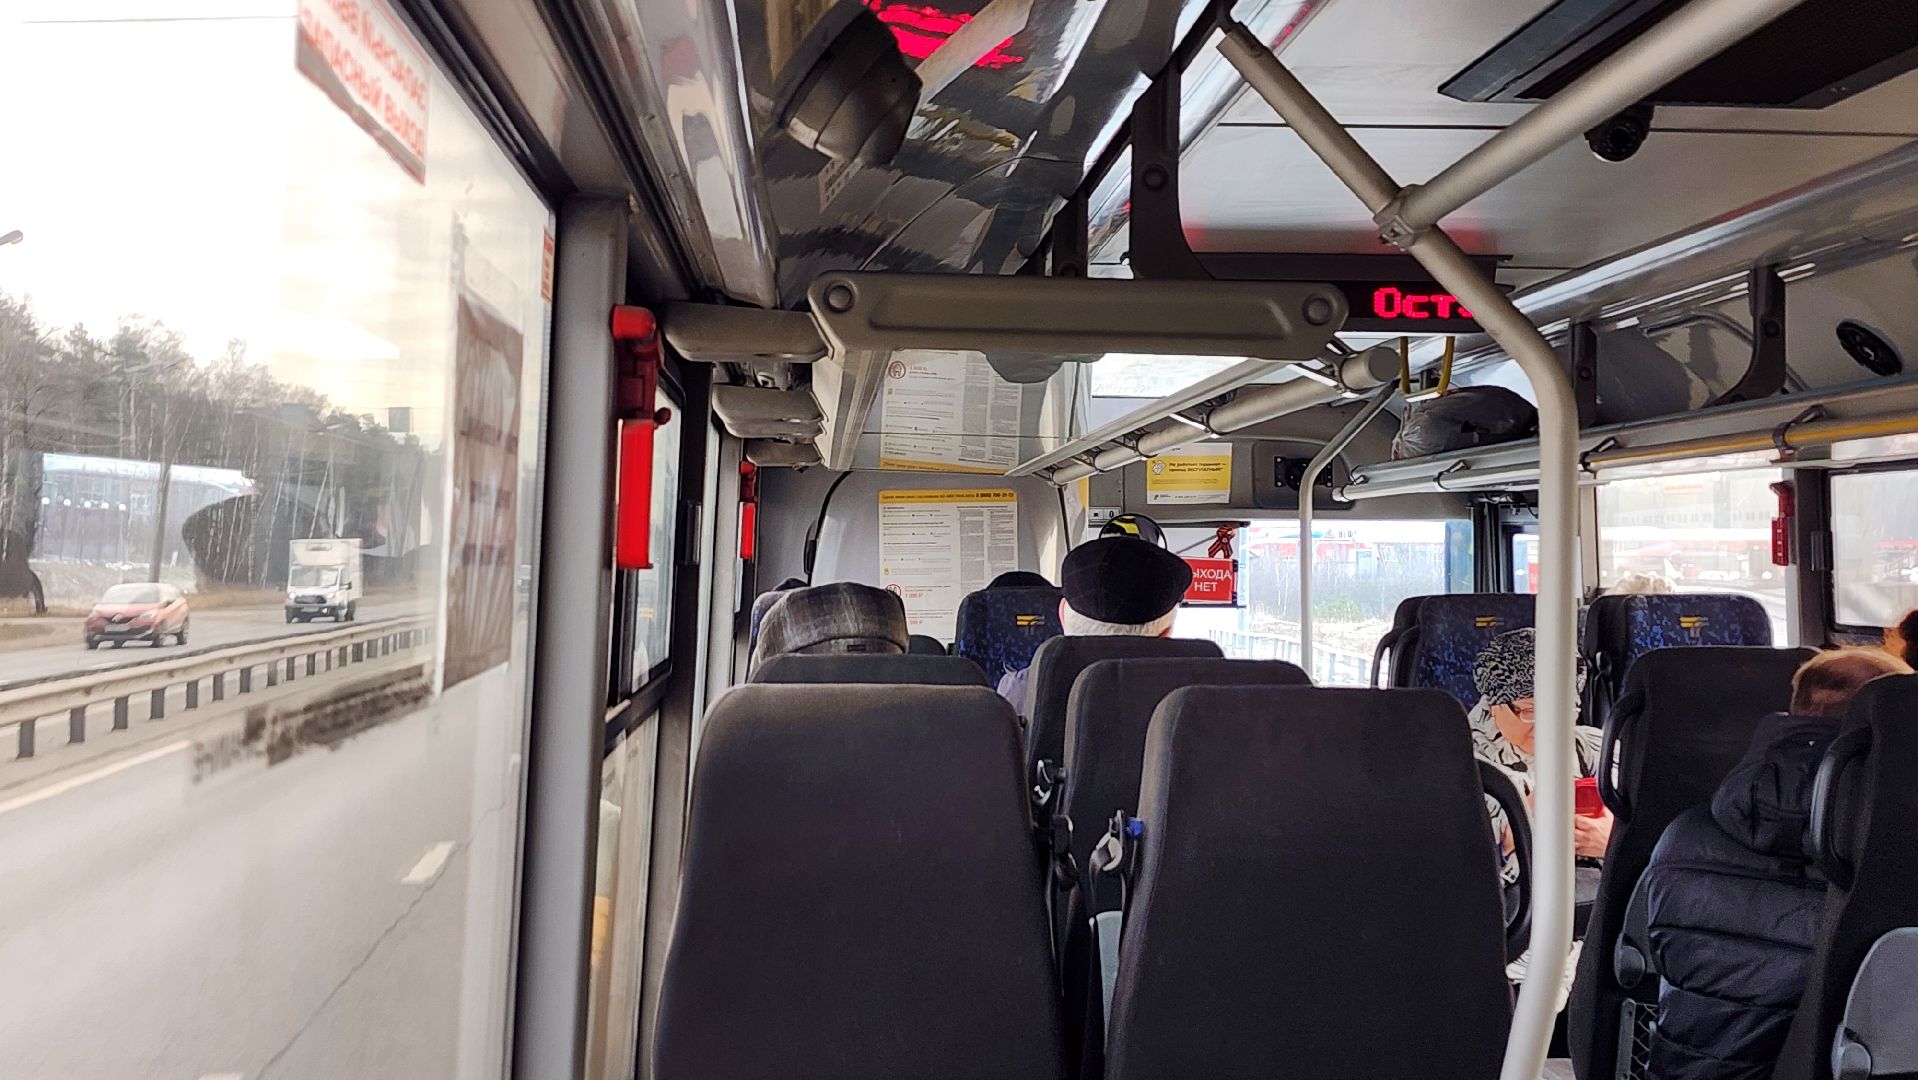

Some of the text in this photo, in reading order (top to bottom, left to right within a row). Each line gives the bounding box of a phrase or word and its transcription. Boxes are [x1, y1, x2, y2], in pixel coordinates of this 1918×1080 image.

[1373, 287, 1474, 318] Ост
[1192, 569, 1232, 580] ЫХОДА
[1194, 582, 1218, 592] НЕТ
